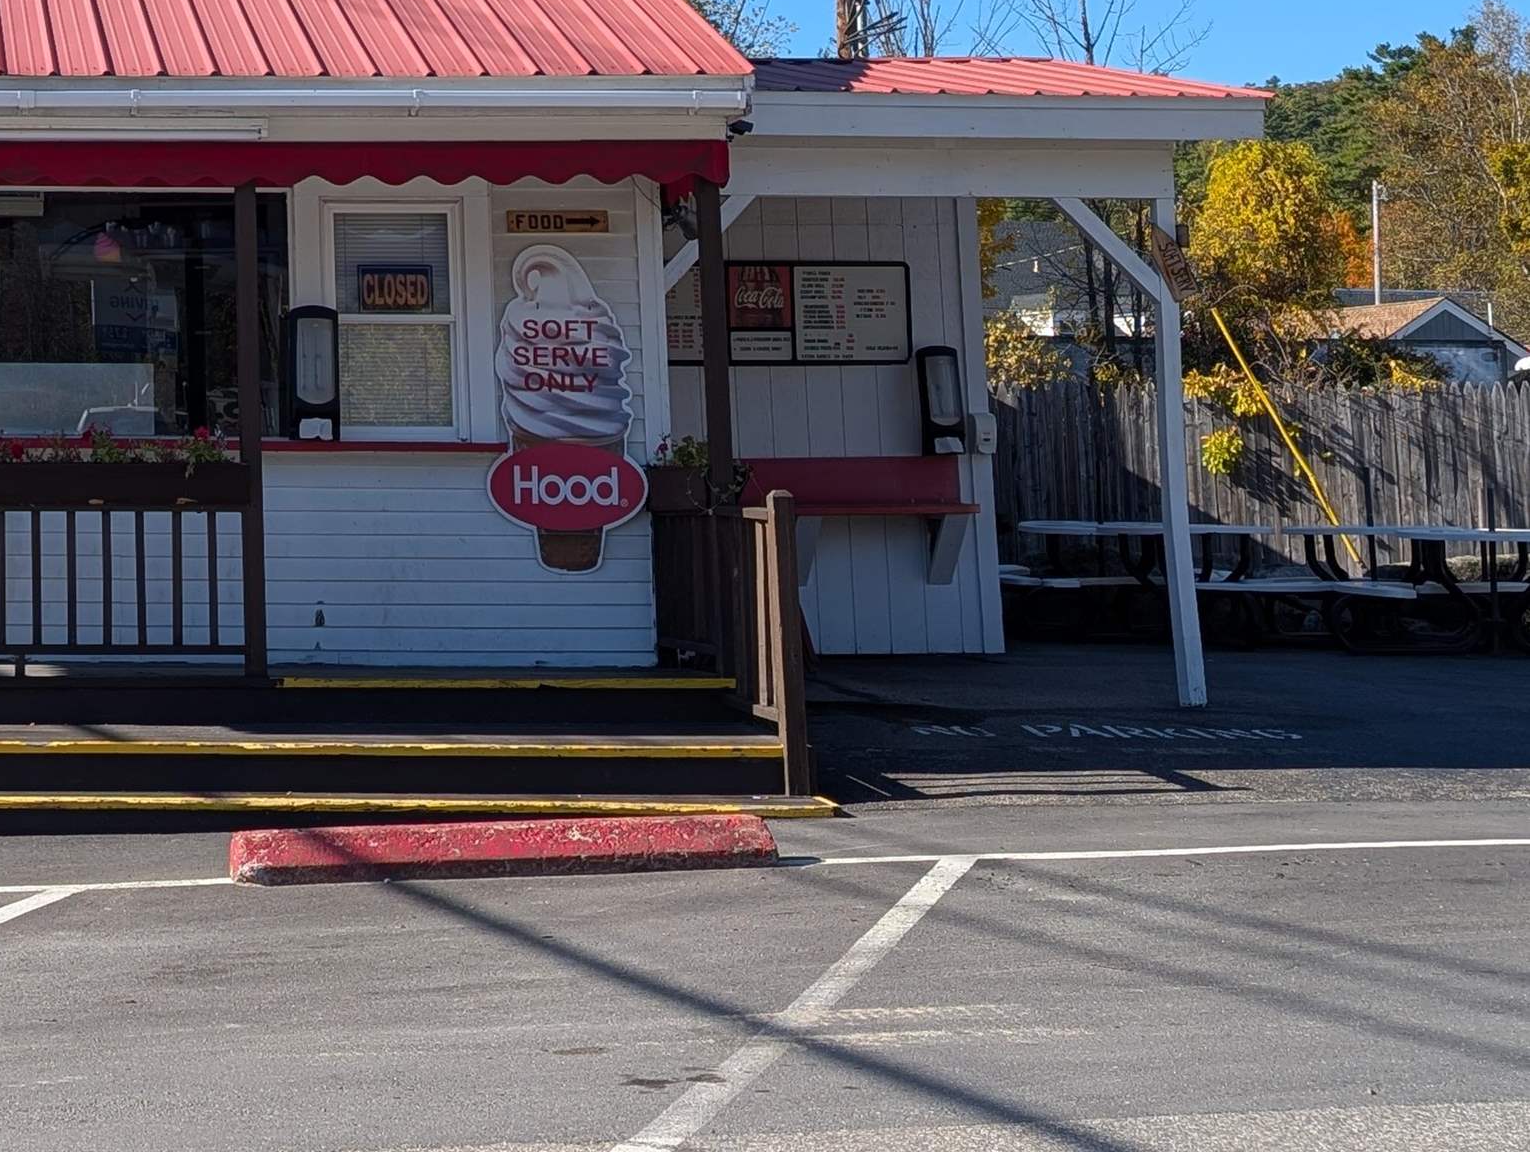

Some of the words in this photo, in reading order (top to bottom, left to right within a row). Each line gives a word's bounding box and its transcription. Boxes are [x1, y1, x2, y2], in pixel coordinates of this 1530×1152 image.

[515, 213, 565, 230] FOOD
[362, 273, 429, 305] CLOSED
[522, 319, 599, 341] SOFT
[513, 346, 610, 368] SERVE
[524, 372, 599, 394] ONLY
[512, 465, 619, 506] Hood
[1021, 723, 1303, 740] PARKING
